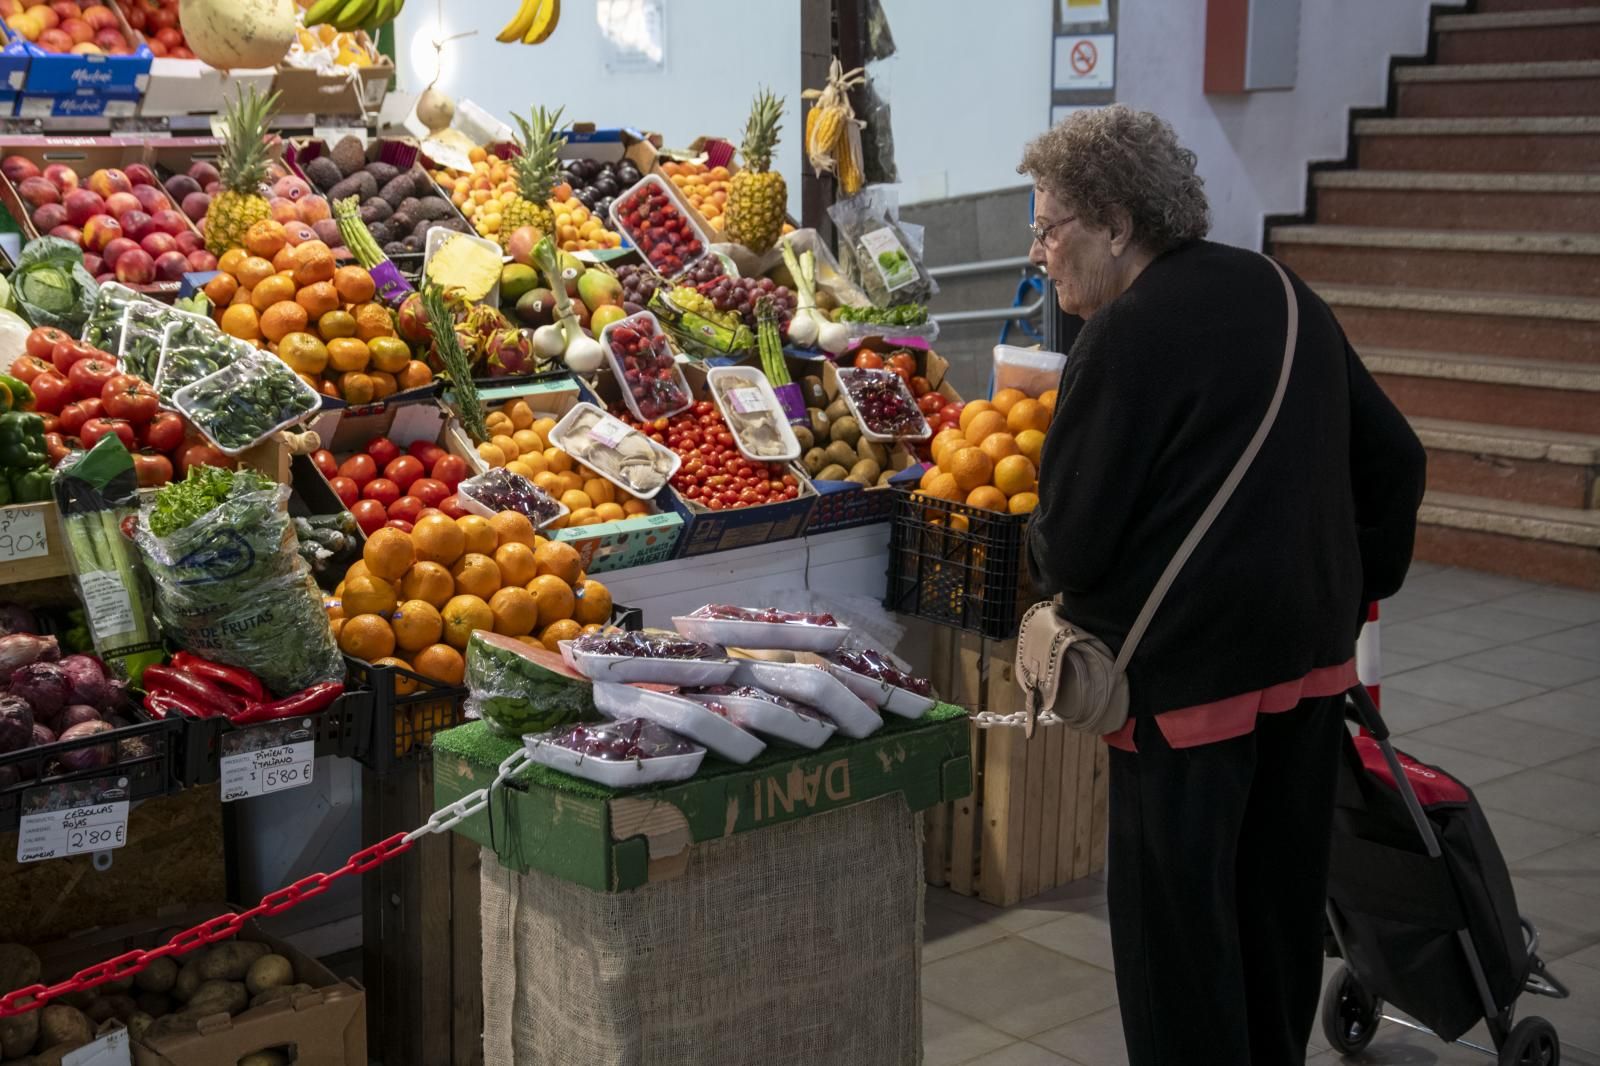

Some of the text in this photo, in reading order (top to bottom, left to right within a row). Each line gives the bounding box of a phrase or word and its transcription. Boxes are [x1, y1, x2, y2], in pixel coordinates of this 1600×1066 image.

[221, 610, 274, 636] FRUTAS
[753, 758, 850, 821] DANI
[62, 818, 87, 830] ROJAS
[64, 805, 113, 820] CEBOLLAS
[71, 825, 123, 848] 2'80 €
